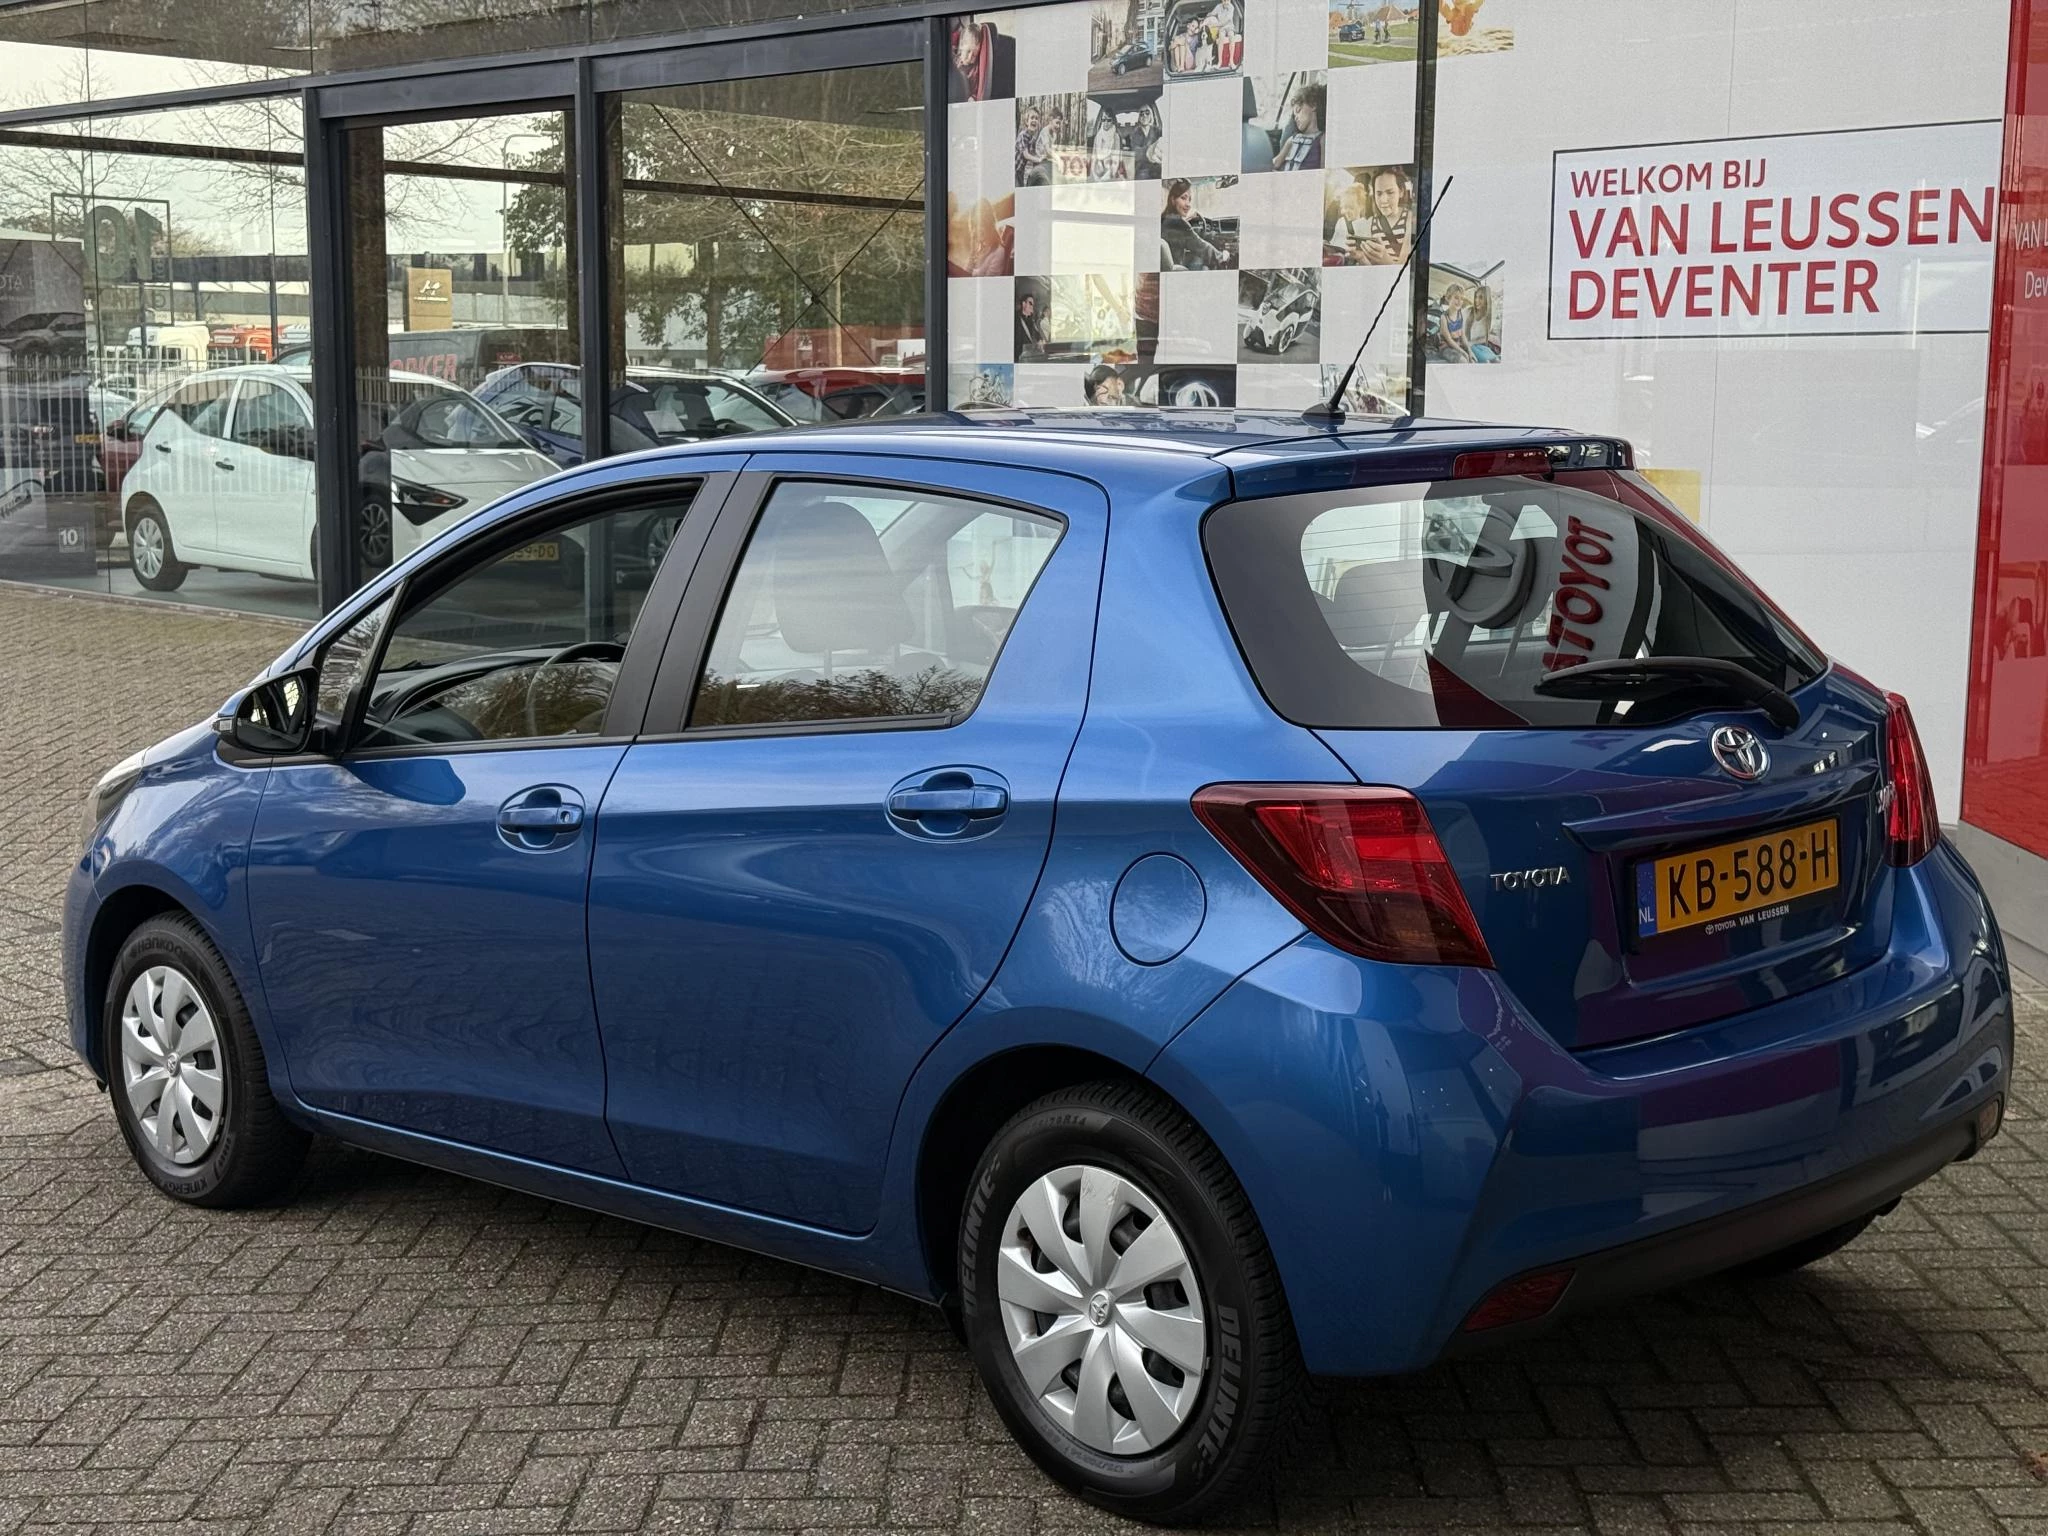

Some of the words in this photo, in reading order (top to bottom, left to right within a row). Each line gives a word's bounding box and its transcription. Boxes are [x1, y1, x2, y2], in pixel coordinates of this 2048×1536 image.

[1570, 161, 1712, 198] WELKOM
[1722, 158, 1766, 189] BIJ
[1569, 203, 1690, 259] VAN
[1710, 186, 1995, 254] LEUSSEN
[2014, 219, 2041, 251] VAN
[1569, 259, 1880, 320] DEVENTER
[60, 529, 78, 546] 10
[1490, 866, 1571, 893] TOYOTA
[1668, 829, 1830, 919] KB-588-H
[1638, 908, 1655, 925] NL
[1714, 921, 1736, 933] TOYOTA
[1739, 913, 1755, 926] VAN
[1758, 904, 1790, 921] LEUSSEN
[961, 1167, 996, 1319] DELINTE
[1197, 1304, 1242, 1465] DELINTE
